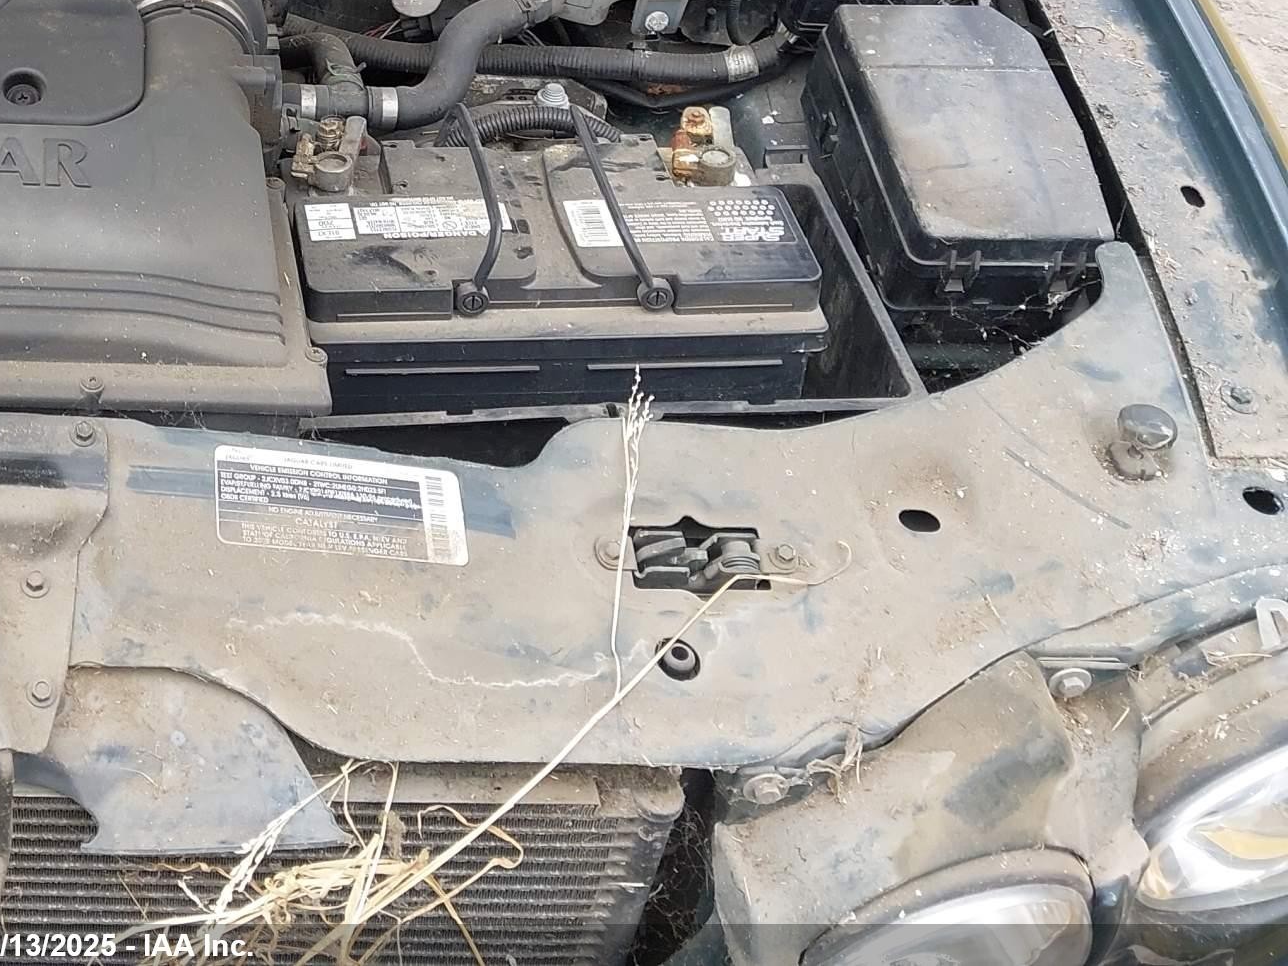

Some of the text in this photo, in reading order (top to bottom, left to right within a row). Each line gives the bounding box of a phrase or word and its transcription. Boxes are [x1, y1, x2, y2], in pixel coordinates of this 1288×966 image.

[722, 234, 781, 242] SUPER
[249, 464, 388, 485] VEHICLE EMISSION CONTROL INFORMATION
[295, 517, 338, 530] CATALYST
[327, 530, 338, 538] TO
